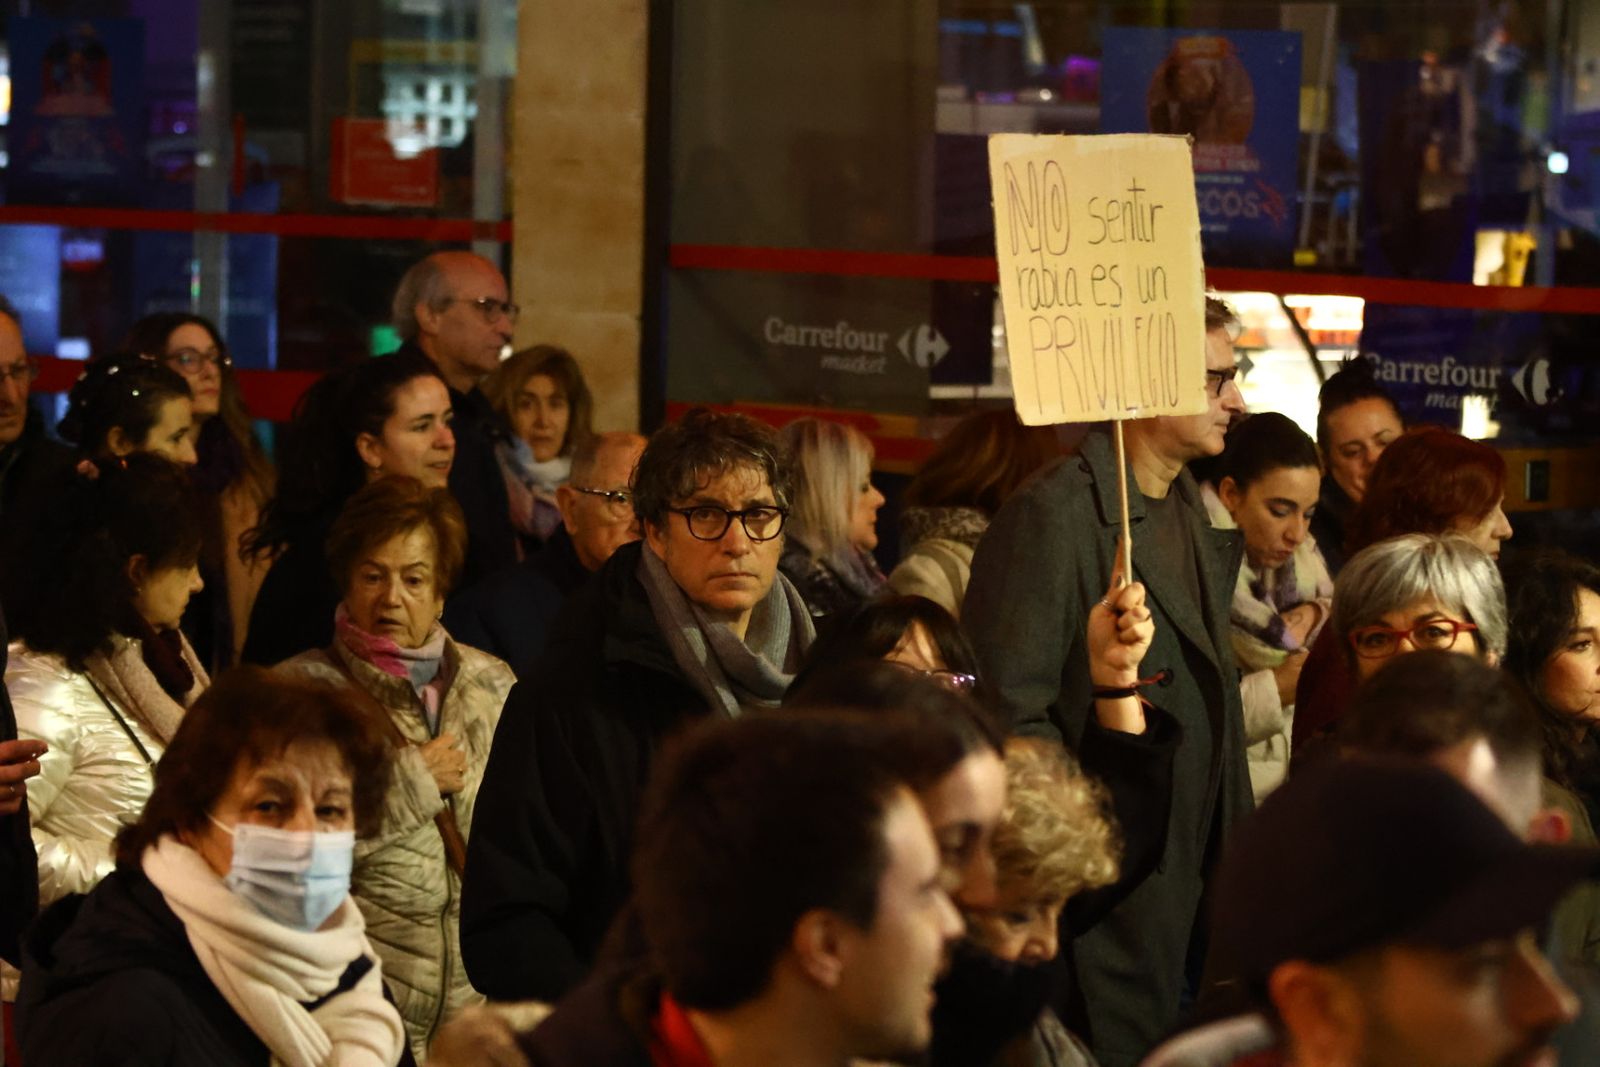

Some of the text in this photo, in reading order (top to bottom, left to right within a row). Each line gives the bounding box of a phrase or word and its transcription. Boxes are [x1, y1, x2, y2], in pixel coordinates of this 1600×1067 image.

[1004, 160, 1163, 256] NO sentir
[1016, 252, 1168, 311] rabia es un
[765, 317, 888, 351] Carrefour
[821, 355, 886, 374] market
[1029, 312, 1179, 416] PRIVILEGIO
